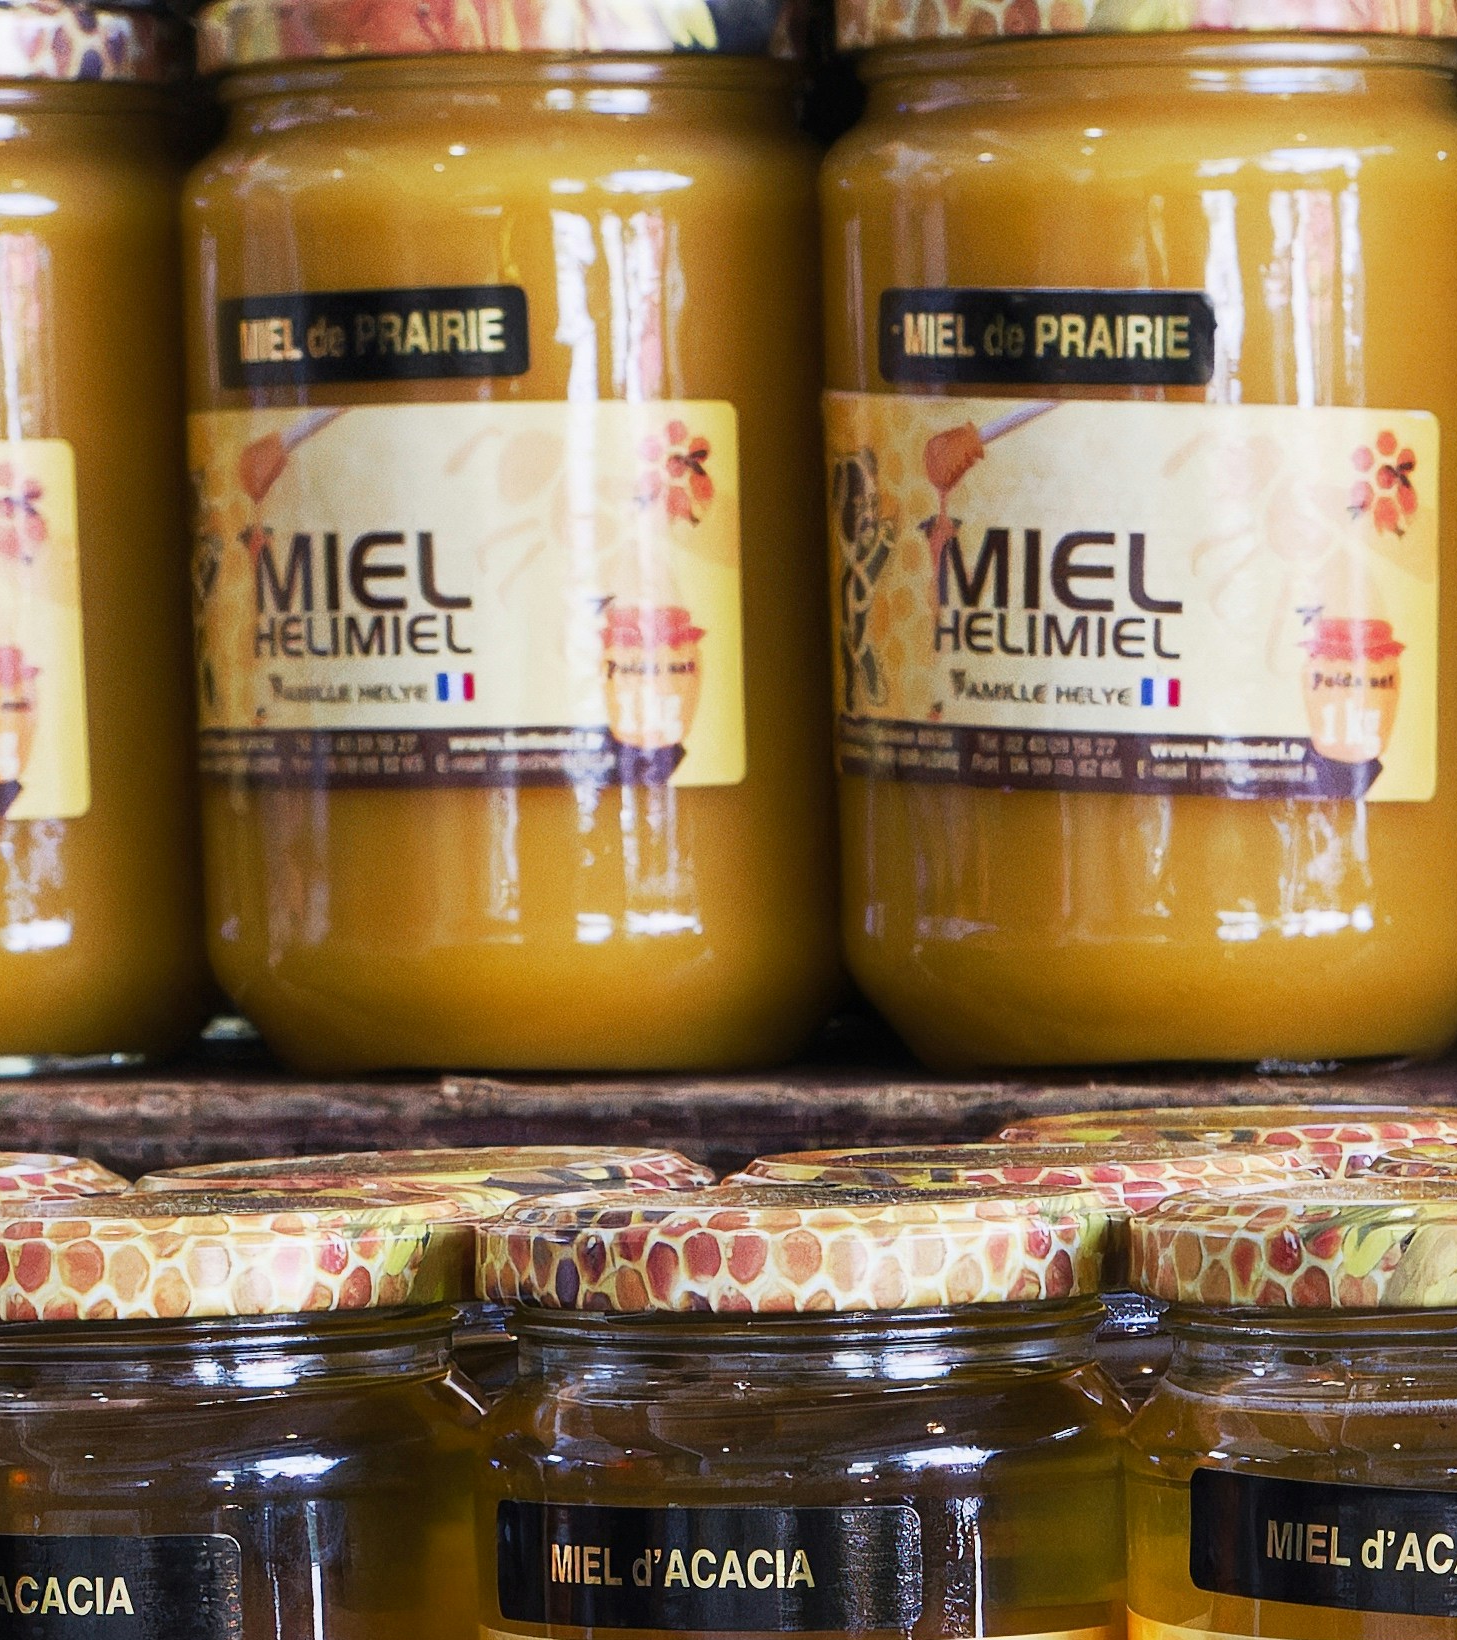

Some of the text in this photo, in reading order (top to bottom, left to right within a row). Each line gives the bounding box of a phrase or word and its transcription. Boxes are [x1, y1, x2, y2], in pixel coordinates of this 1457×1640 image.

[355, 309, 506, 356] PRAIRIE
[904, 314, 1190, 359] MIEL de PRAIRIE
[254, 532, 472, 612] MIEL
[939, 530, 1182, 613] MIEL
[254, 615, 473, 659] HELIMIEL
[935, 613, 1180, 659] HELIMIEL
[1055, 685, 1131, 706] HELYE
[1267, 1519, 1350, 1567] MIEL
[551, 1545, 815, 1589] MIEL d'ACACIA
